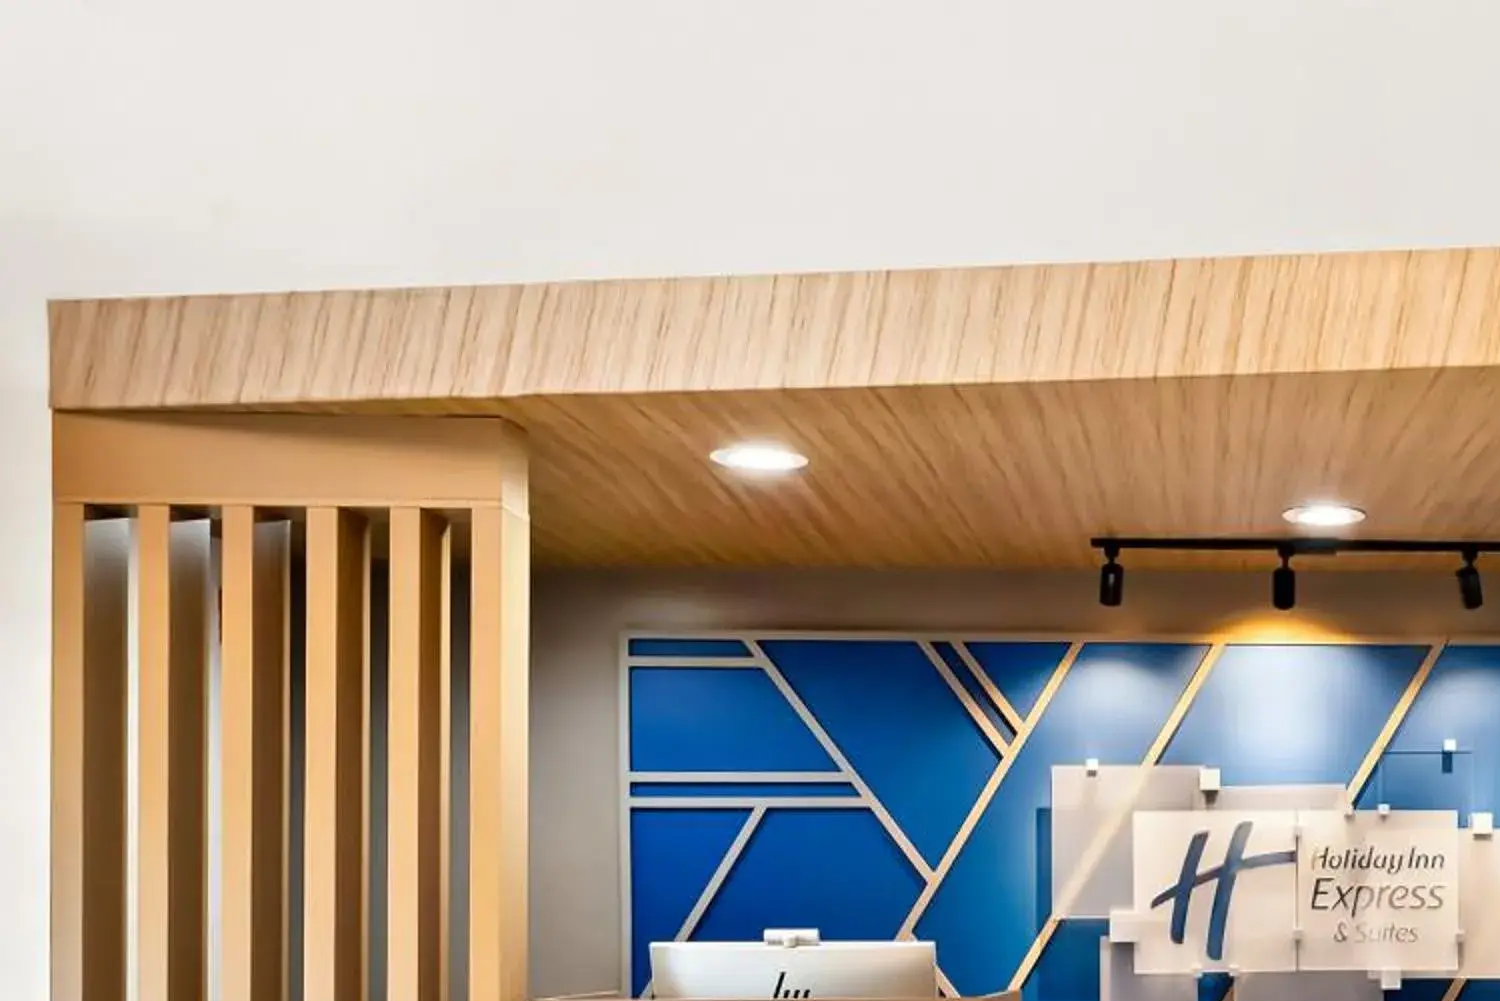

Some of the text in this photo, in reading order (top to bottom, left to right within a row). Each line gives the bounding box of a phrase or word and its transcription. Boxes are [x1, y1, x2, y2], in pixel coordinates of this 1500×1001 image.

[1311, 846, 1445, 874] Holiday Inn
[1311, 877, 1446, 918] Express
[1334, 922, 1418, 942] & Suites
